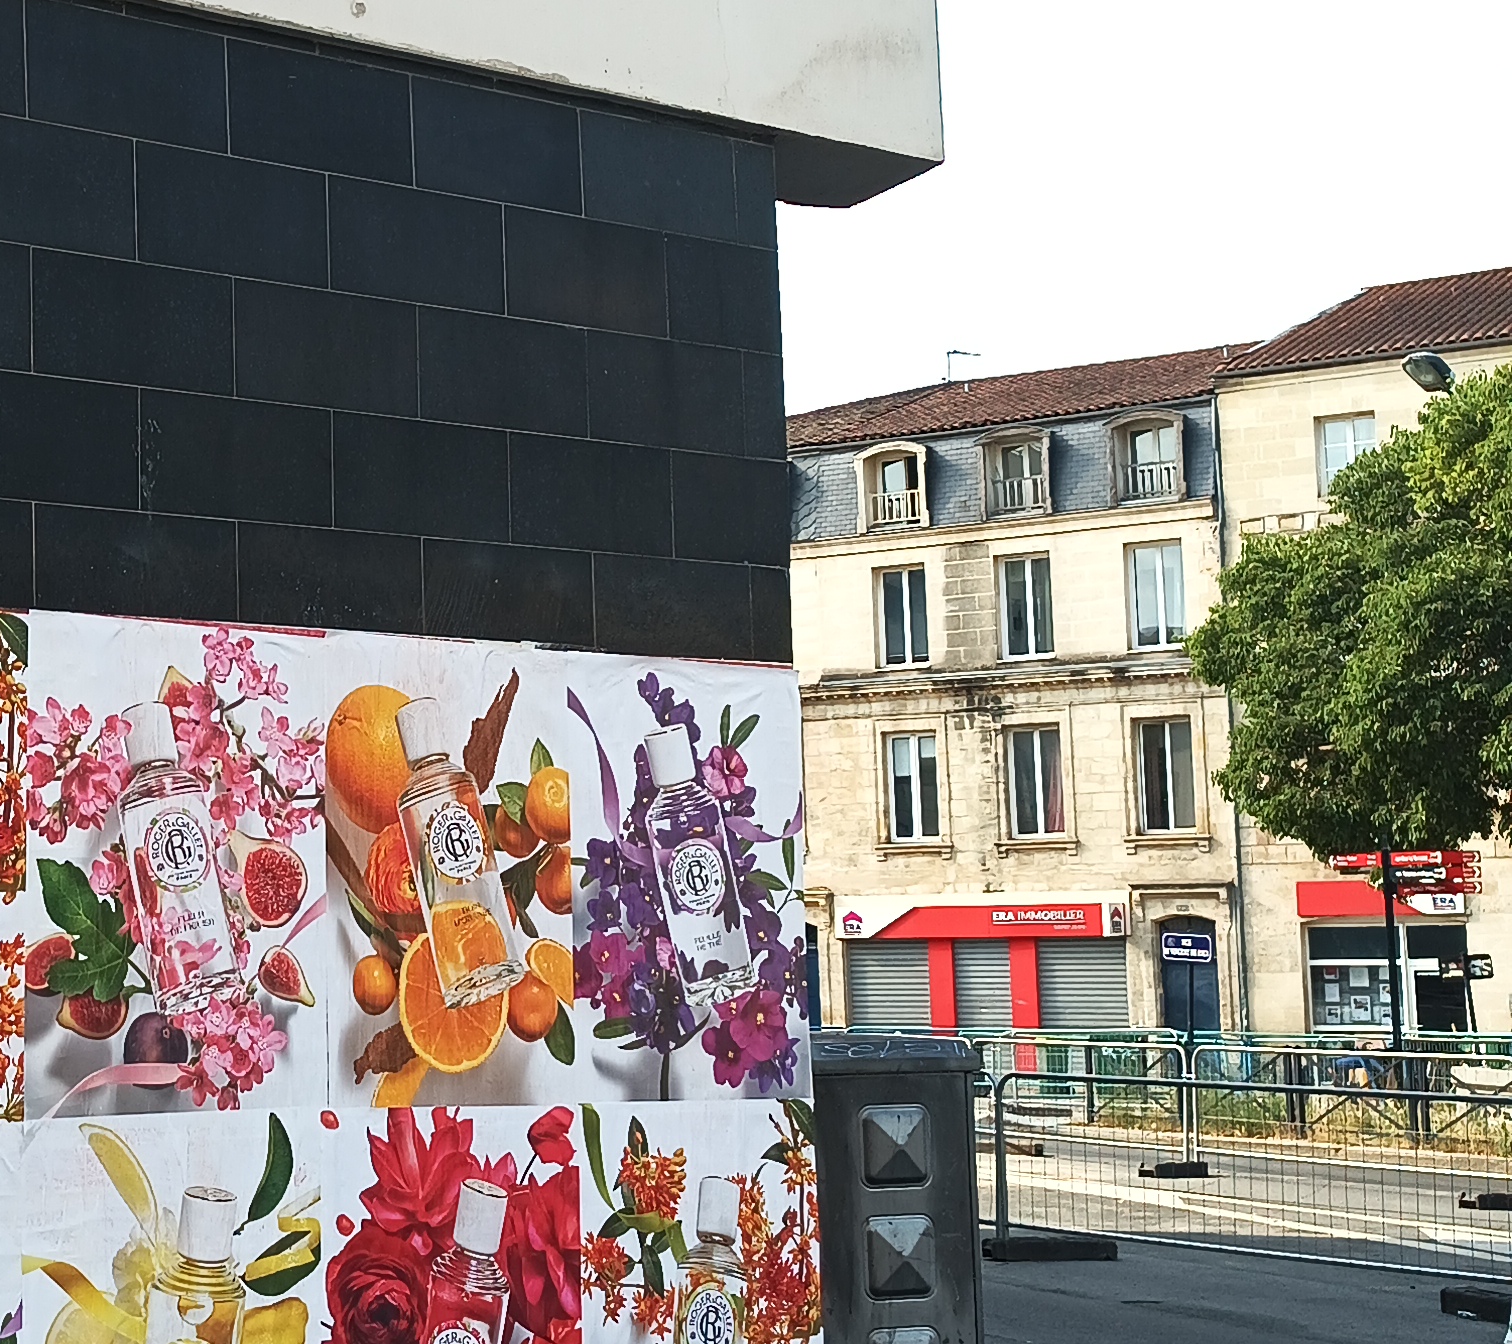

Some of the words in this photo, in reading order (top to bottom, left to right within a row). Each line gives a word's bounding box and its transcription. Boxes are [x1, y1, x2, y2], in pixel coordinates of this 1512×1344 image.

[1433, 897, 1456, 907] ERA
[992, 911, 1015, 920] ERA
[1018, 910, 1084, 920] IMMOBILIER
